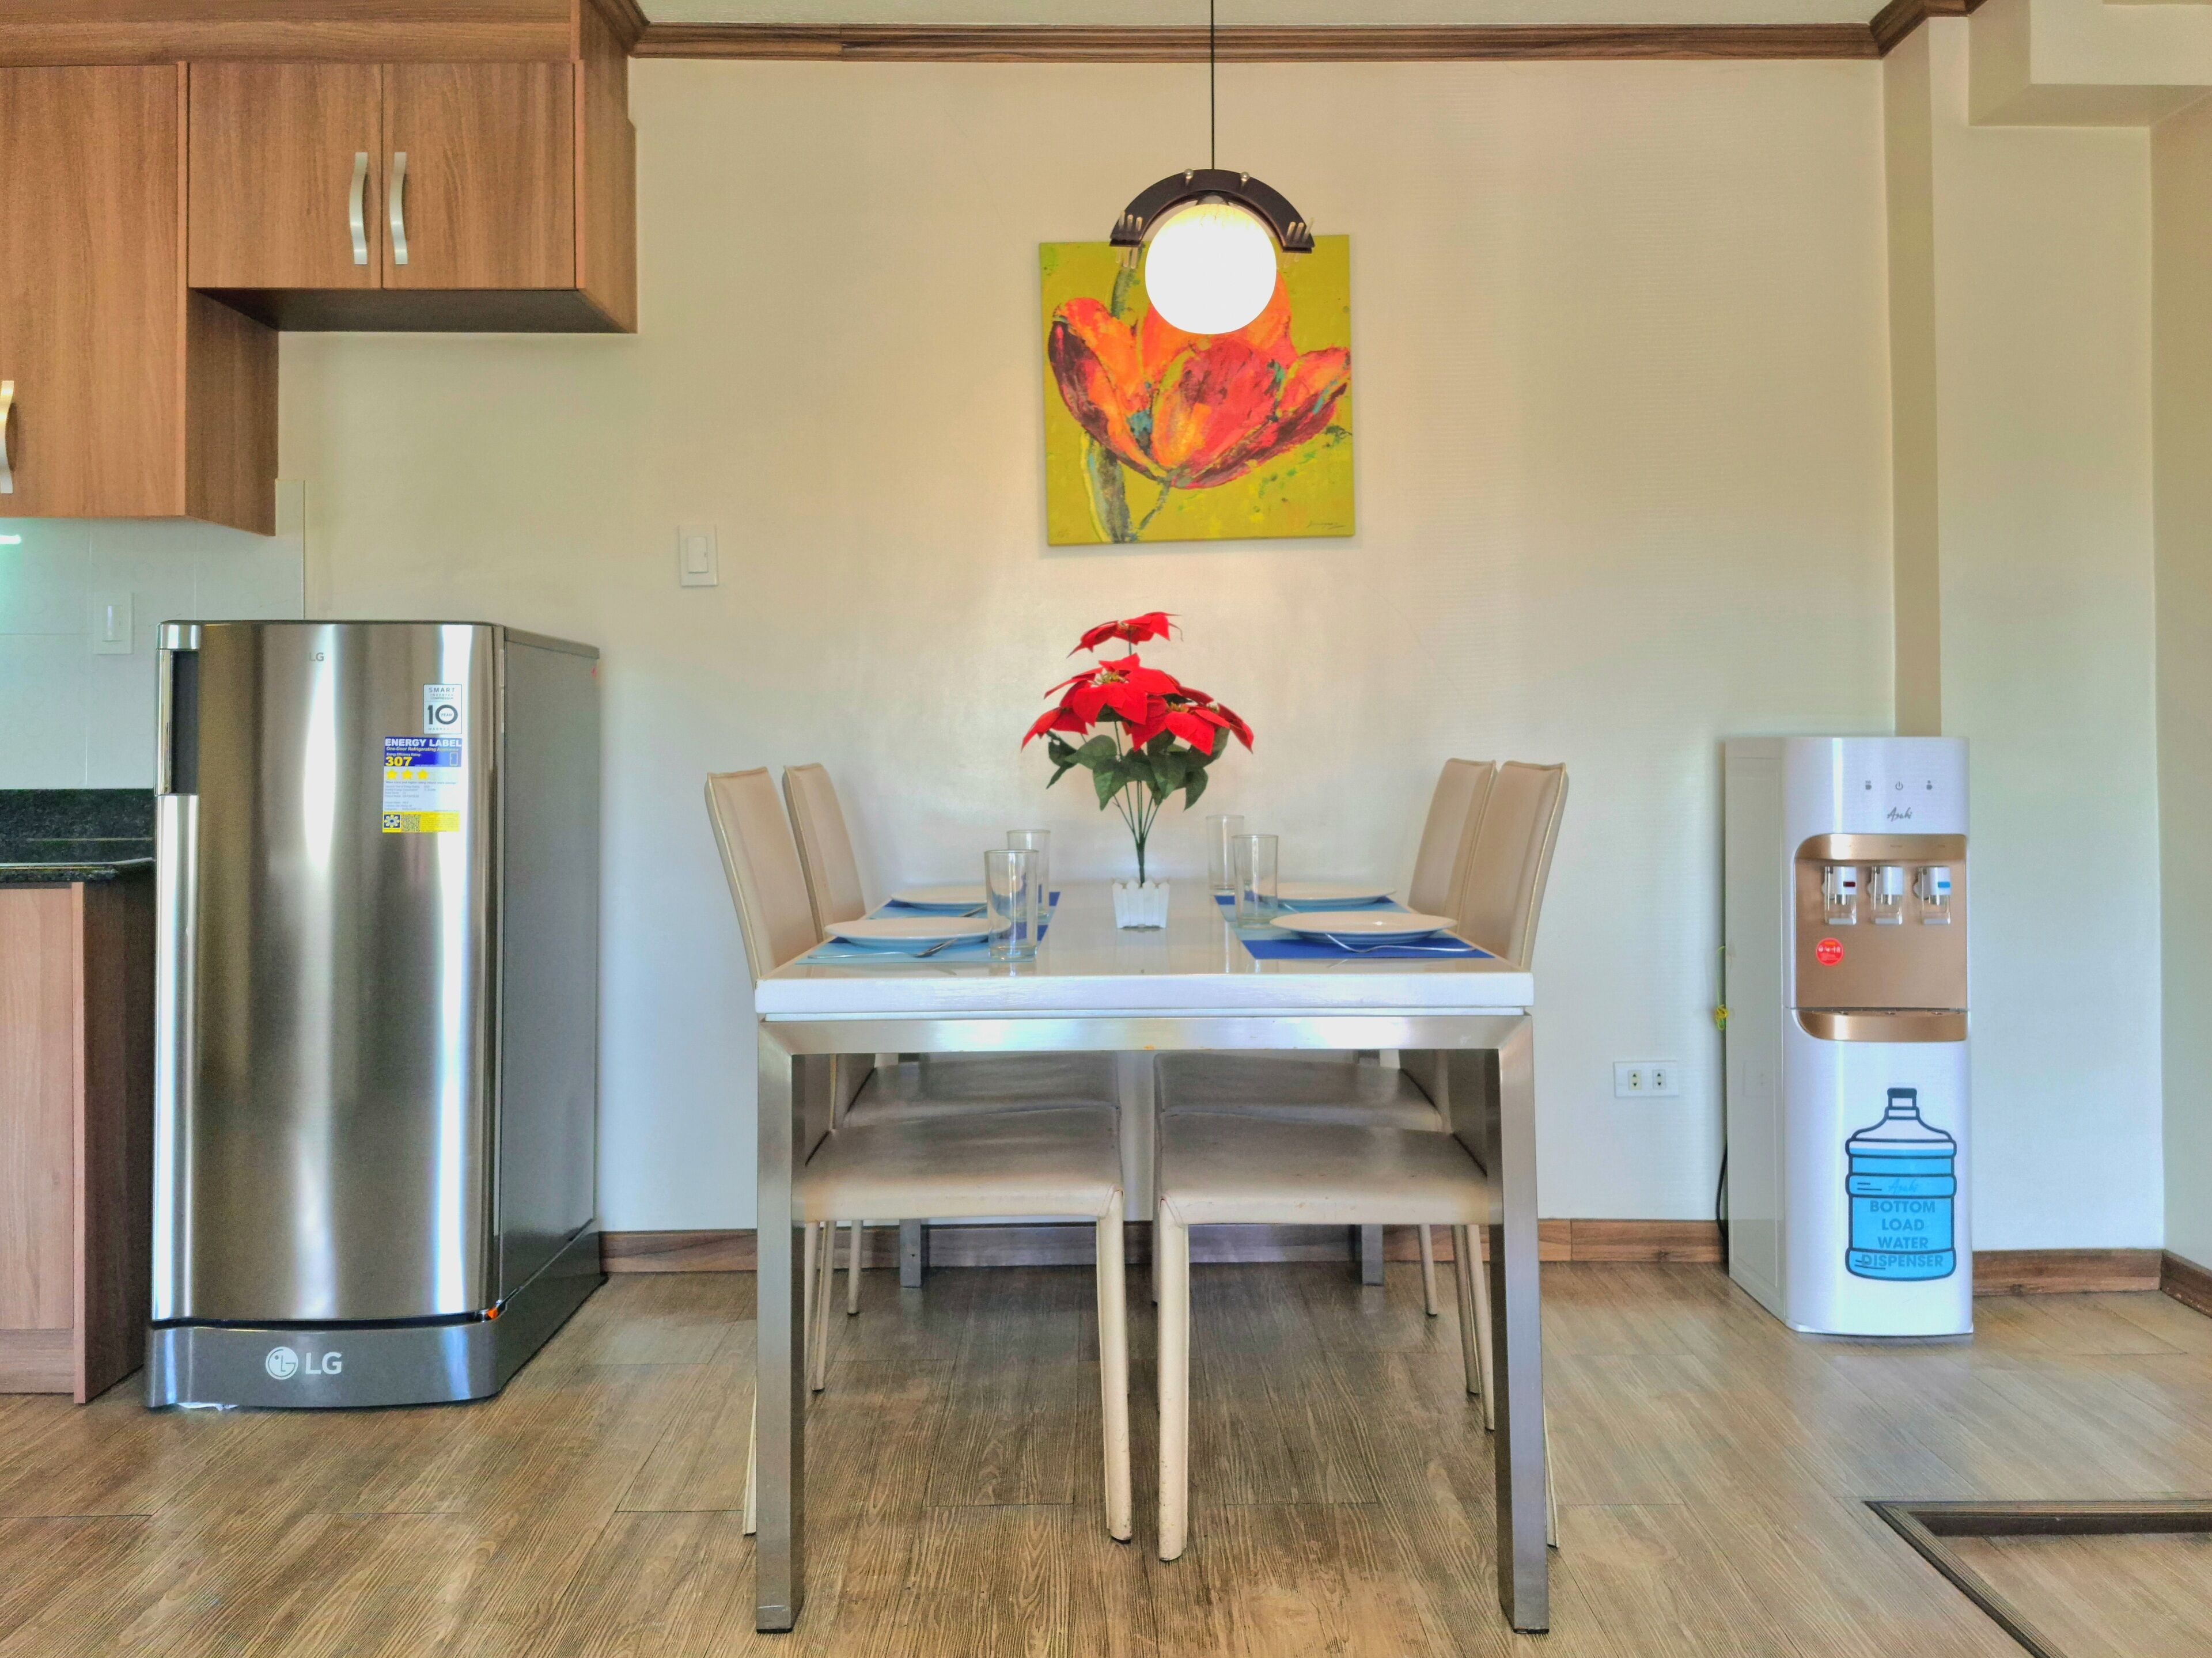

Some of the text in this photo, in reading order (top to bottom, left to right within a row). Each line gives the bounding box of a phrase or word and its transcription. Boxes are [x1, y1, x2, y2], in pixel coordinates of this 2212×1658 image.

[309, 652, 324, 662] LG
[427, 704, 459, 724] 10
[385, 738, 462, 747] ENERGY LABEL
[385, 756, 412, 767] 307
[1887, 806, 1912, 822] Asahi
[1870, 1200, 1936, 1213] BOTTOM
[1881, 1218, 1925, 1231] LOAD
[1877, 1236, 1929, 1249] WATER
[1861, 1254, 1944, 1267] DISPENSER
[305, 1352, 342, 1375] LG
